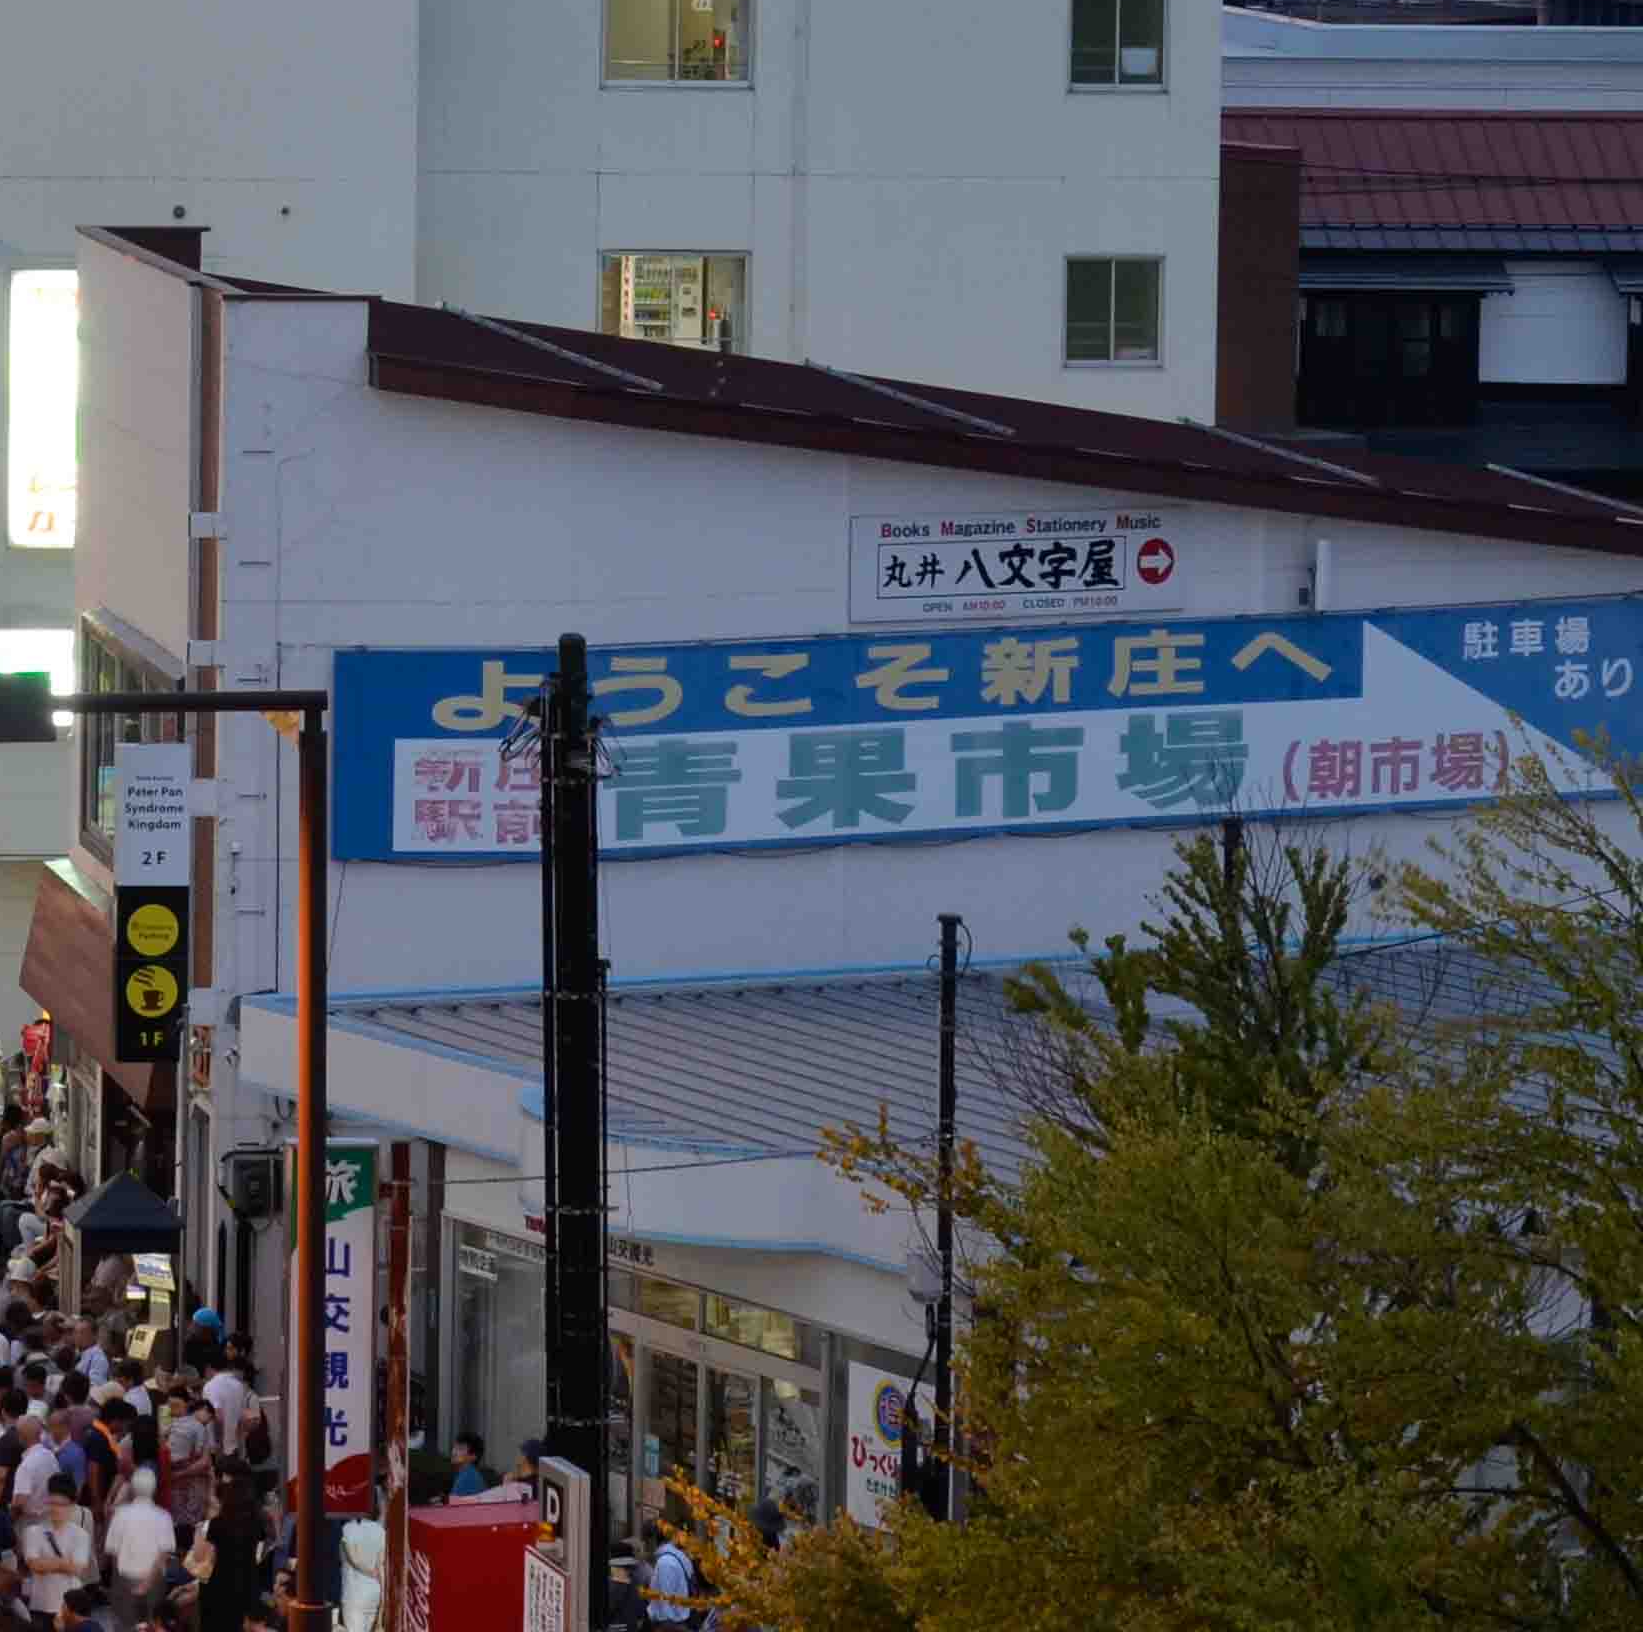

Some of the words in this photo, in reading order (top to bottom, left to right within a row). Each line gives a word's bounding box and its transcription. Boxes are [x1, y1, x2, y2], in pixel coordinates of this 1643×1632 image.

[880, 522, 930, 538] Books
[940, 519, 1015, 537] Magazine
[1025, 517, 1106, 534] Stationery
[1115, 514, 1161, 530] Music
[883, 553, 945, 589] 丸井
[955, 539, 1120, 589] 八文字屋
[923, 601, 953, 613] OPEN
[1023, 598, 1065, 609] CLOSED
[1463, 617, 1591, 661] 駐車場
[1553, 657, 1634, 702] あり
[603, 711, 1248, 841] 青果市場
[127, 785, 159, 799] Peter
[161, 785, 183, 798] Pan
[125, 801, 184, 816] Syndrome
[128, 818, 182, 833] Kingdom
